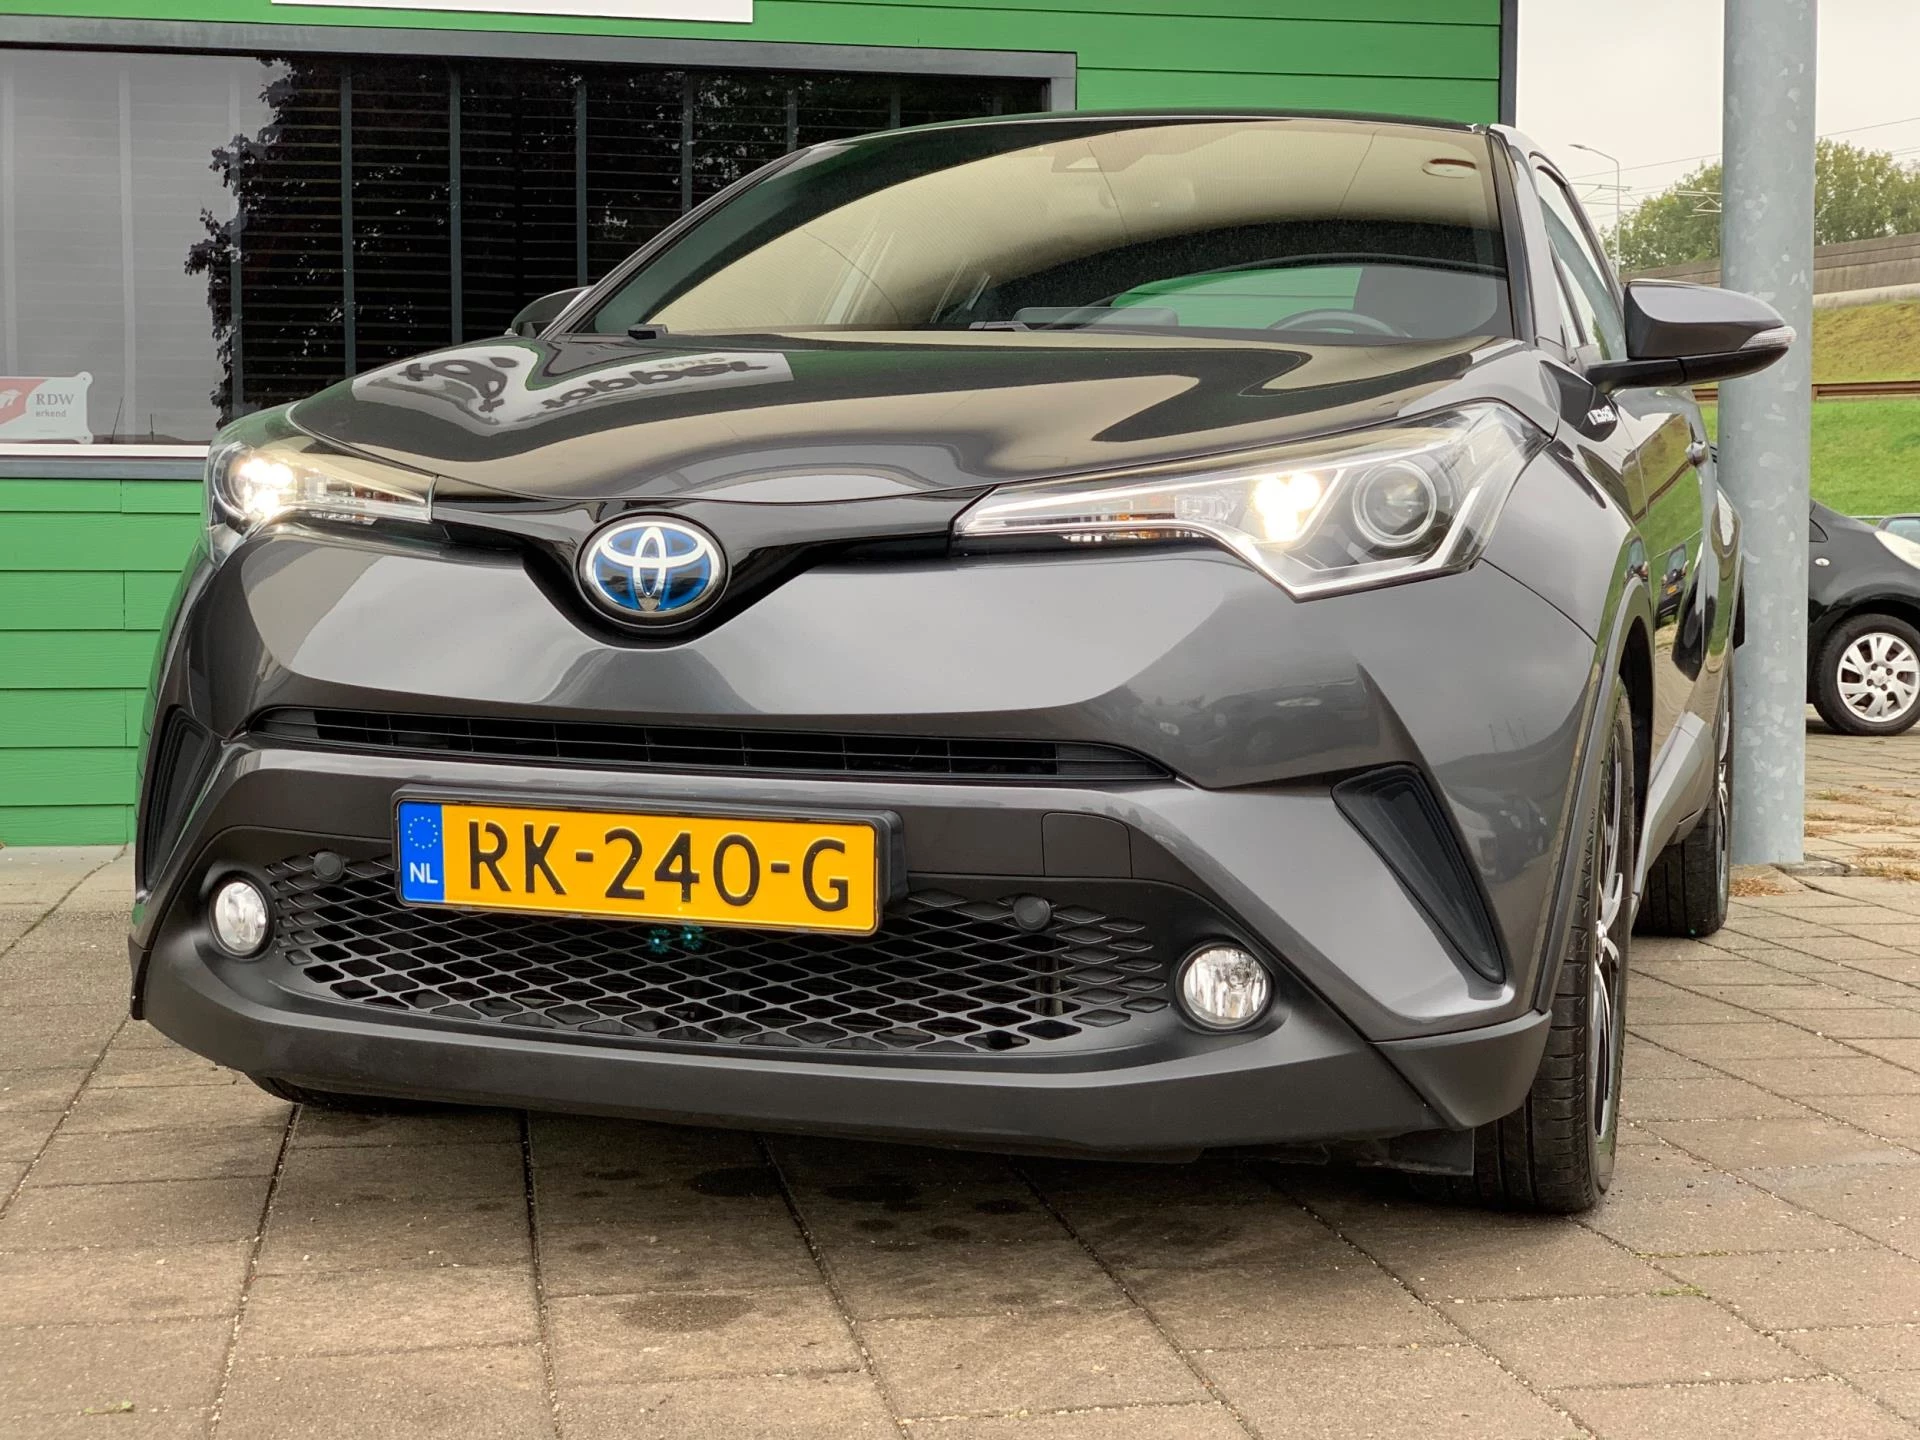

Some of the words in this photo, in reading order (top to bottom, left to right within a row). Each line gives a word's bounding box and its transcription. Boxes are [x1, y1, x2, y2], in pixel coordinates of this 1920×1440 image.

[36, 393, 74, 405] RDW
[36, 409, 67, 417] erkend
[409, 861, 438, 884] NL
[468, 819, 850, 912] RK-240-G
